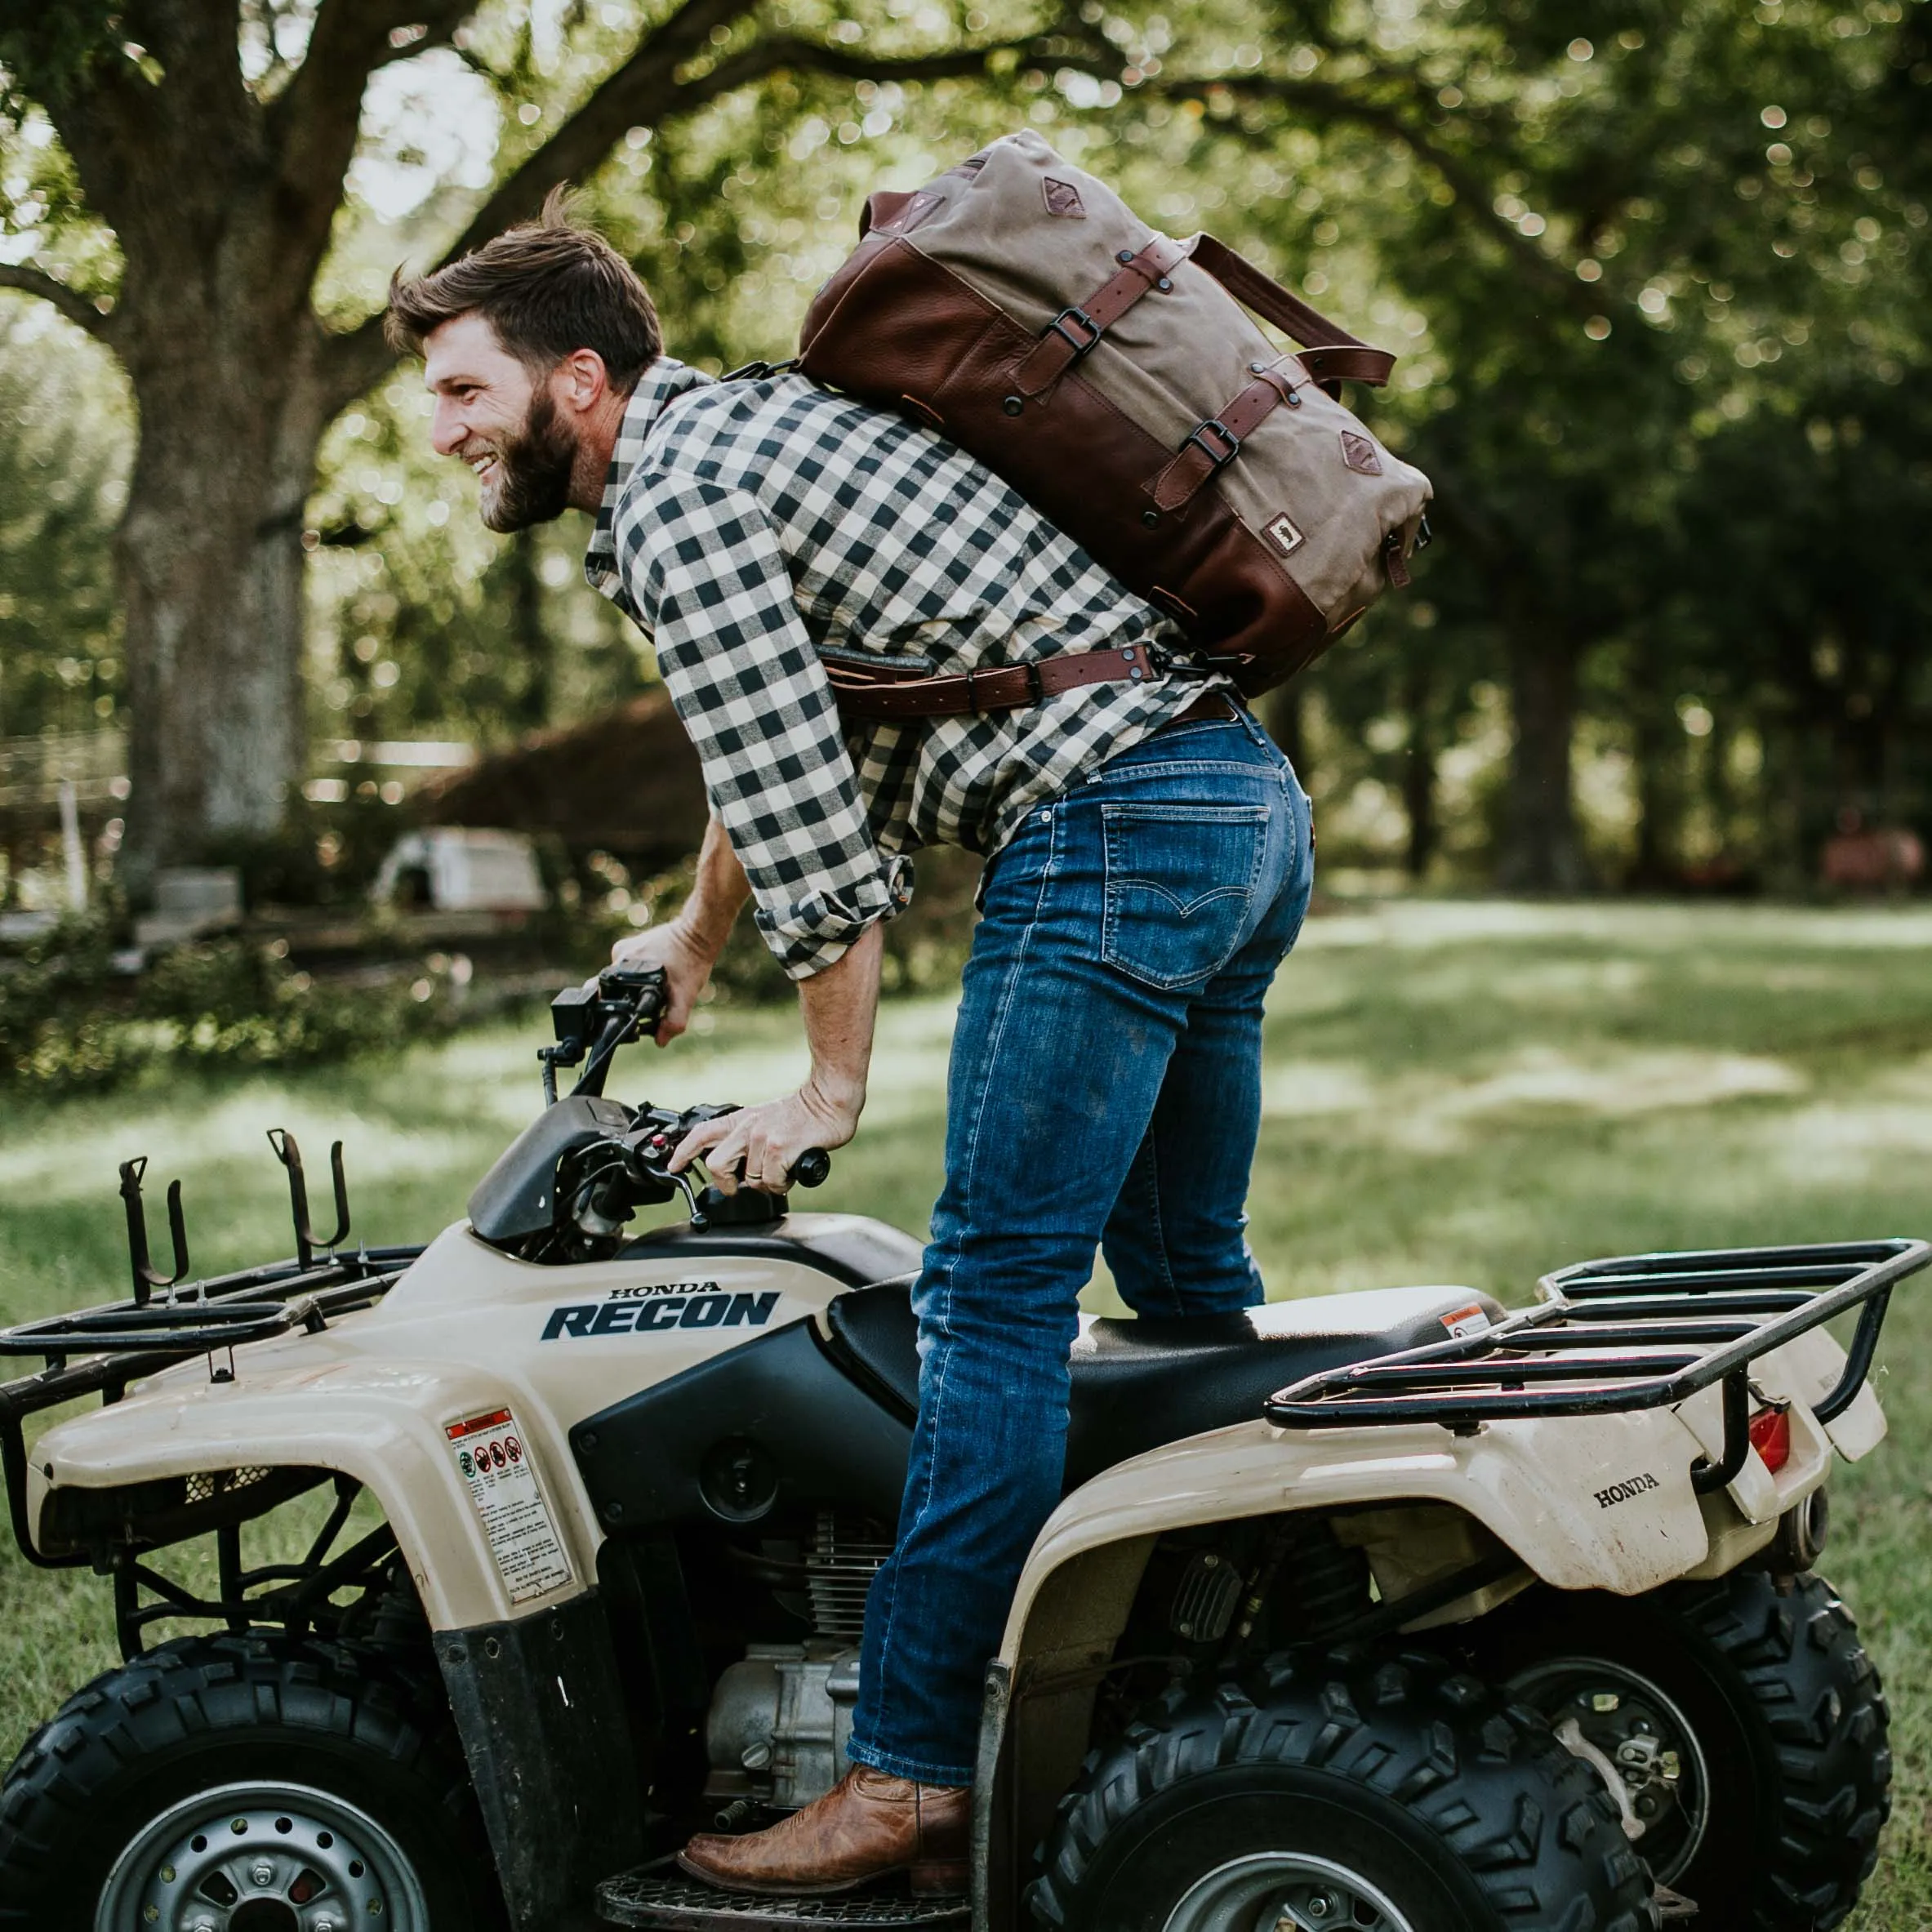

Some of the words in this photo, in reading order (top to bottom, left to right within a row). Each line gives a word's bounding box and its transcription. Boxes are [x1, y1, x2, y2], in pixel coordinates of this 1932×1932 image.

[608, 1281, 722, 1300] HONDA
[541, 1292, 781, 1341] RECON
[1593, 1472, 1660, 1509] HONDA
